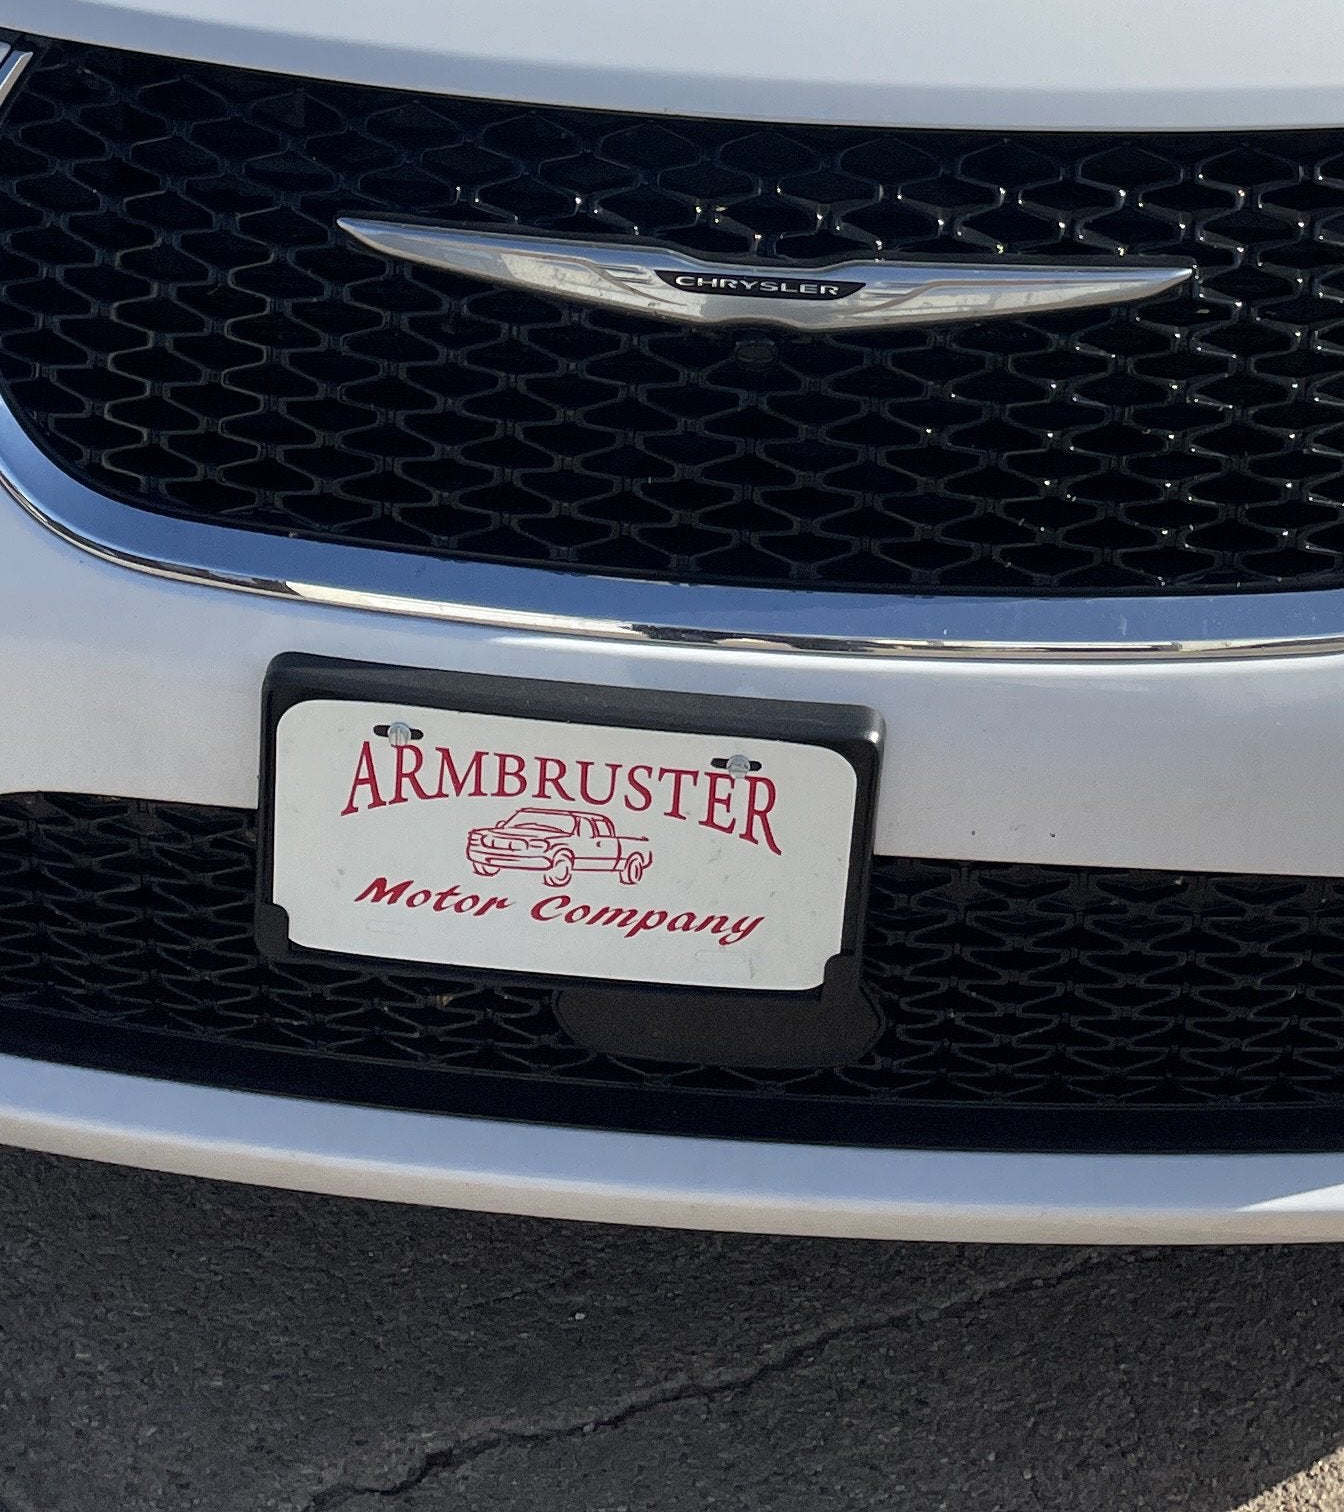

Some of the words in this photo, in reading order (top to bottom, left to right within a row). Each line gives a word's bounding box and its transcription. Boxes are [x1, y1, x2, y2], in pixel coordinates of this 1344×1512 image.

[675, 275, 839, 297] CHRYSLER
[340, 740, 783, 857] ARMBRUSTER
[354, 876, 515, 918] Motor
[530, 895, 767, 947] Company
